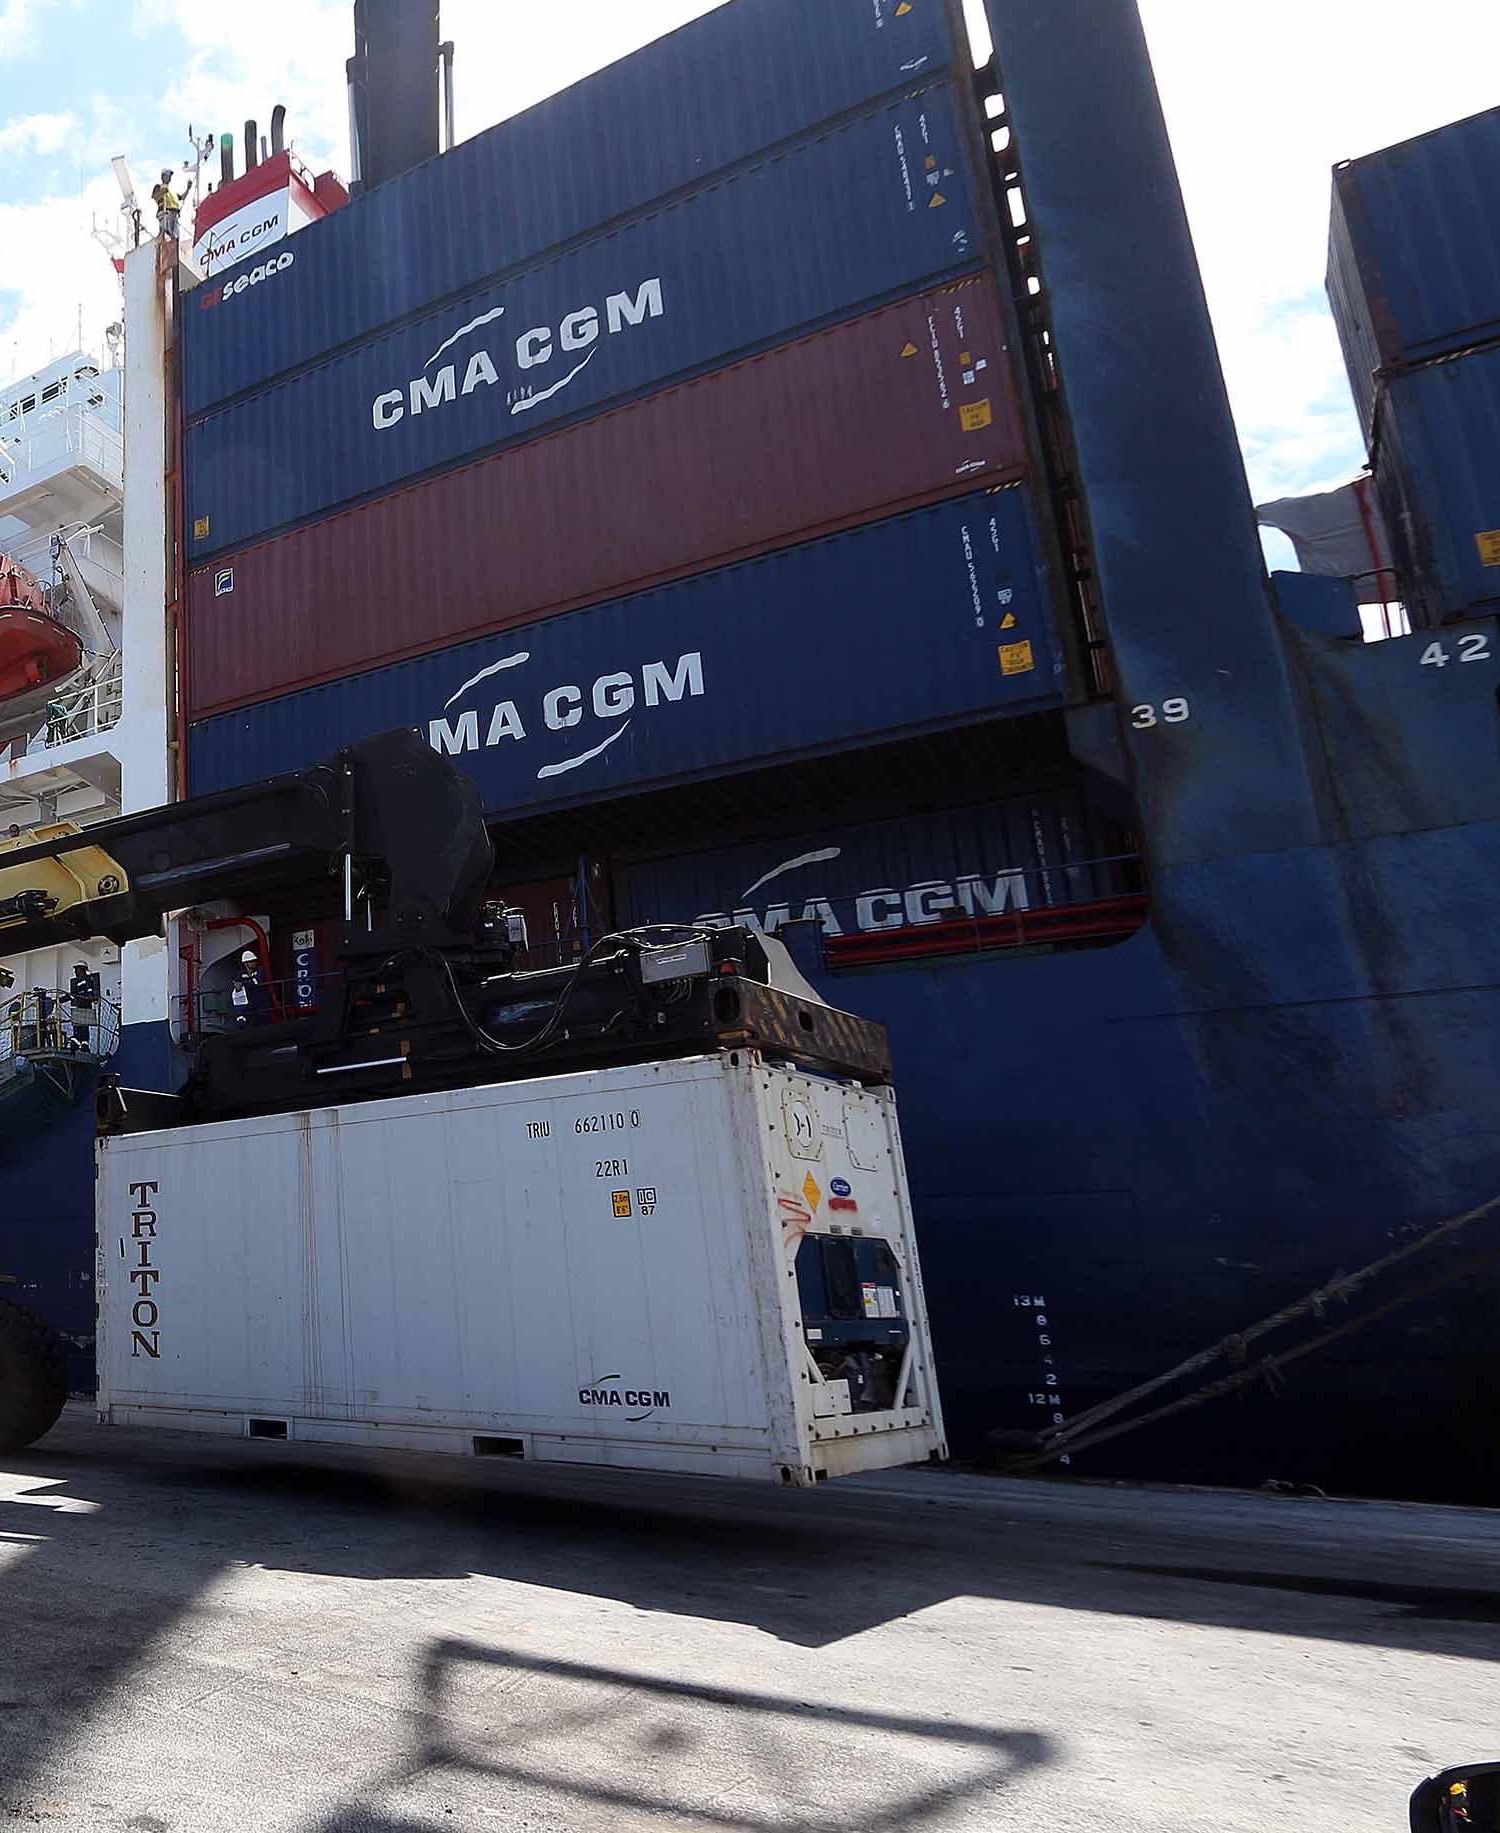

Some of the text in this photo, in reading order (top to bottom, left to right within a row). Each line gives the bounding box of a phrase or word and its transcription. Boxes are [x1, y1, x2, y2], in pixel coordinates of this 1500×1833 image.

[200, 215, 278, 266] CMA CGM
[372, 278, 664, 430] CMA CGM
[961, 526, 973, 560] CMAU
[1420, 634, 1491, 667] 42
[543, 652, 705, 729] CGM
[1132, 697, 1189, 729] 39
[857, 866, 1030, 932] CGM
[527, 1110, 640, 1139] TRIU 662110 0
[595, 1159, 628, 1177] 22R1
[641, 1205, 655, 1216] 87
[129, 1181, 161, 1358] TRITON
[1046, 1374, 1057, 1385] 2
[579, 1390, 670, 1407] CMA CGM
